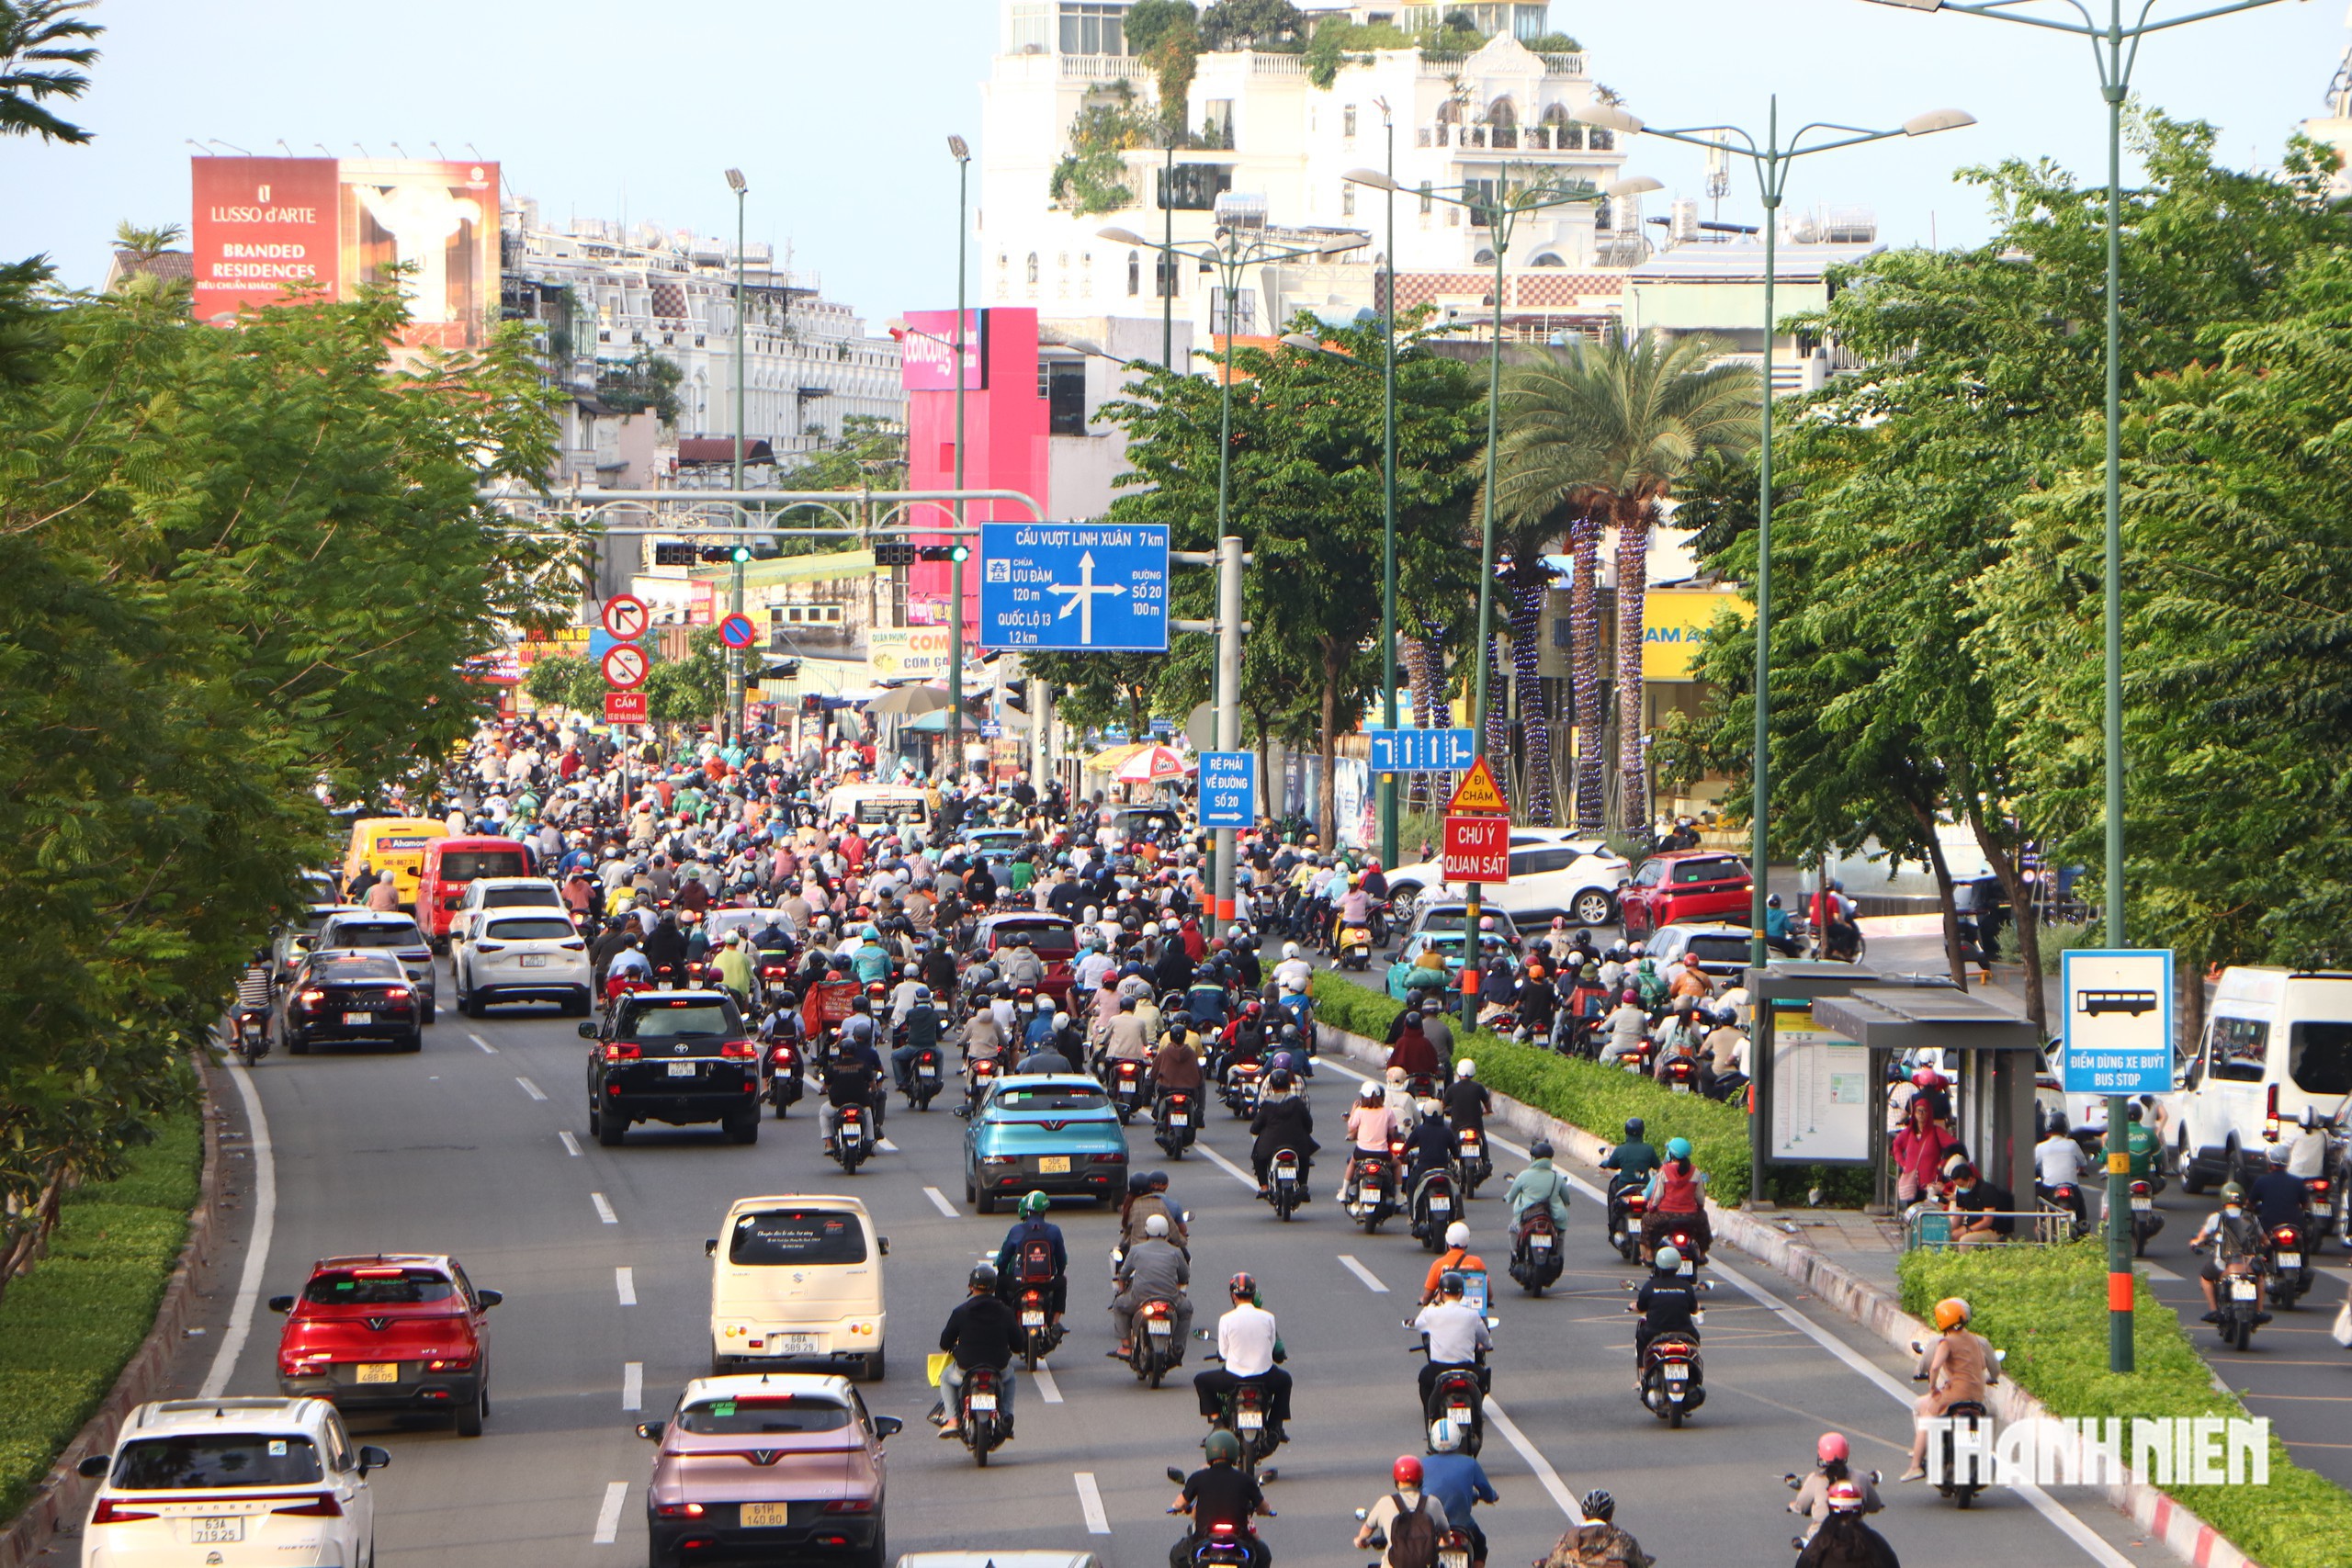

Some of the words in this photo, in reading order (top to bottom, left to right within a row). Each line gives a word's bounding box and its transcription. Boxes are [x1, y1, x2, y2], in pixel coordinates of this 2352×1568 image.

[211, 206, 262, 222] LUSSO
[266, 206, 317, 223] d'ARTE
[223, 243, 305, 258] BRANDED
[212, 263, 316, 278] RESIDENCES
[1041, 530, 1070, 548] VƯỢT
[1072, 532, 1098, 546] LINH
[1101, 529, 1132, 546] XUÂN
[1139, 532, 1147, 546] 7
[1148, 533, 1163, 547] km
[1013, 557, 1034, 567] CHÙA
[1012, 569, 1028, 582] ƯU
[1030, 567, 1052, 583] ĐÀM
[1132, 569, 1161, 580] ĐƯỜNG
[1013, 588, 1030, 601] 120
[1031, 591, 1040, 601] m
[1132, 581, 1148, 599] SỐ
[1149, 585, 1162, 599] 20
[1133, 603, 1149, 615] 100
[1150, 605, 1159, 615] m
[998, 608, 1025, 626] QUỐC
[1026, 610, 1040, 629] LỘ
[1042, 613, 1051, 626] 13
[1023, 632, 1037, 644] km
[616, 694, 638, 708] CẤM
[1155, 761, 1174, 772] OMO
[1210, 756, 1222, 771] RẼ
[1223, 755, 1243, 771] PHẢI
[1205, 773, 1217, 788] VỀ
[1218, 773, 1248, 789] ĐƯỜNG
[1474, 775, 1485, 785] ĐI
[1215, 792, 1227, 807] SỐ
[1227, 795, 1238, 807] 20
[1463, 789, 1494, 803] CHẬM
[1458, 822, 1484, 844] CHÚ
[1487, 822, 1496, 845] Ý
[392, 840, 426, 848] Ahamov
[1445, 855, 1479, 874] QUAN
[1482, 852, 1506, 874] SÁT
[2070, 1051, 2095, 1069] ĐIỂM
[2098, 1054, 2124, 1069] DỪNG
[2126, 1055, 2138, 1068] XE
[2142, 1053, 2165, 1068] BUÝT
[2095, 1073, 2114, 1087] BUS
[2117, 1073, 2142, 1087] STOP
[164, 1503, 267, 1512] HYUNDAI
[753, 1504, 775, 1514] 61H
[205, 1519, 226, 1529] 63A
[748, 1515, 782, 1525] 140.80
[196, 1529, 235, 1542] 719.25
